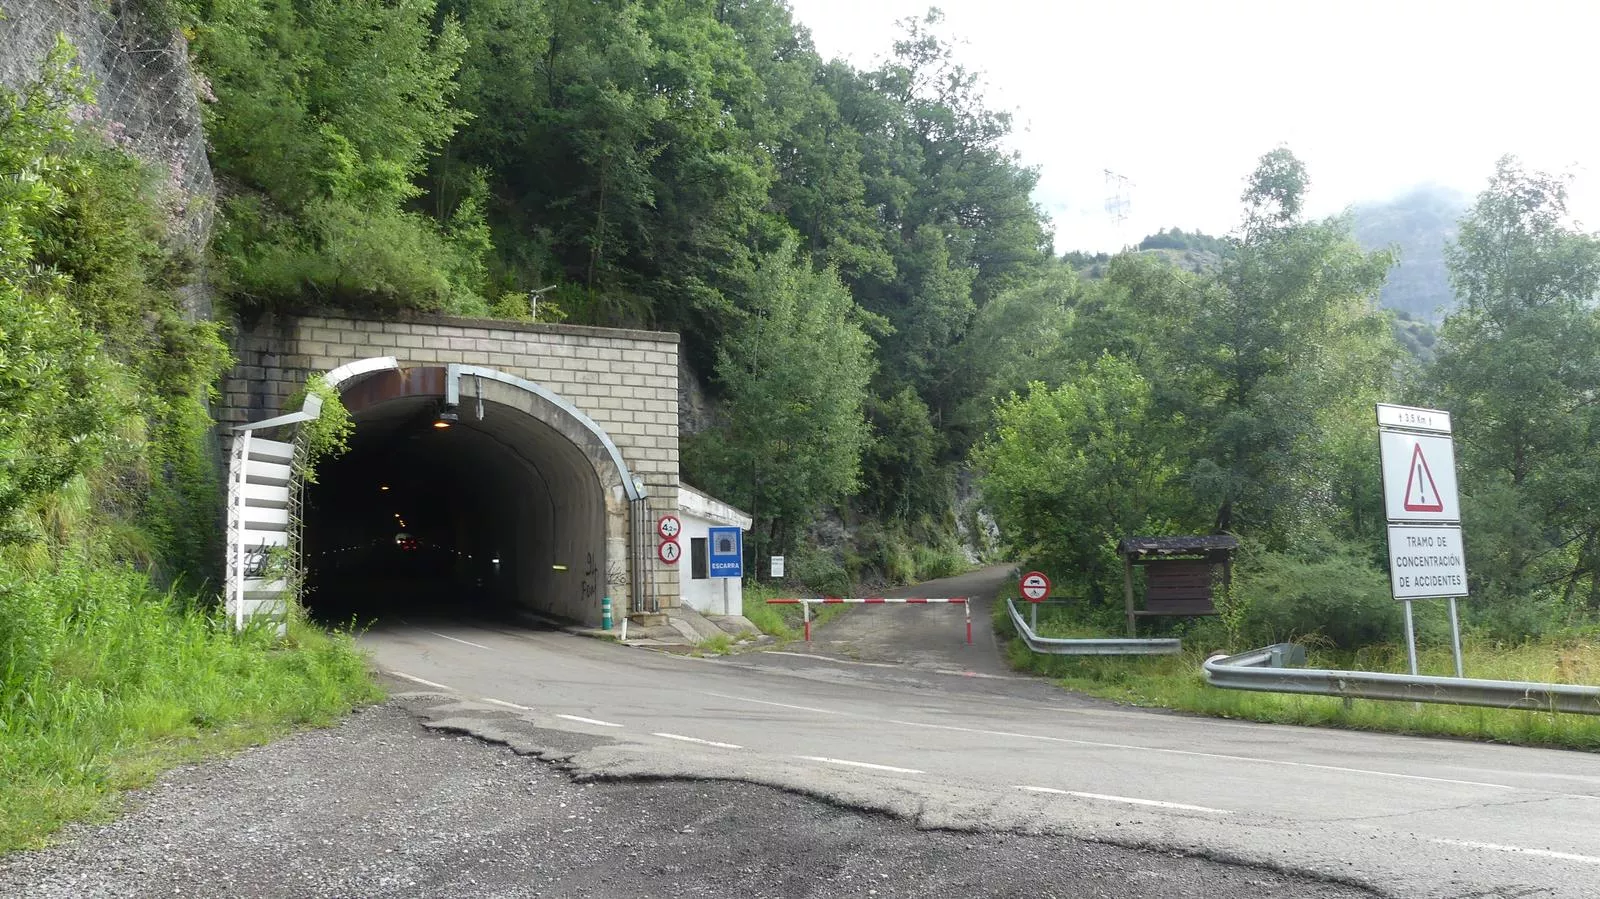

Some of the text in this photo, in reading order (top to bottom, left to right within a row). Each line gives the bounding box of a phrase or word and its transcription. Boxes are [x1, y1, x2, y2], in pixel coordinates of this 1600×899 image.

[1407, 536, 1447, 547] TRAMO DE
[1396, 553, 1460, 567] CONCENTRACIÓN
[1400, 575, 1461, 587] DE ACCIDENTES
